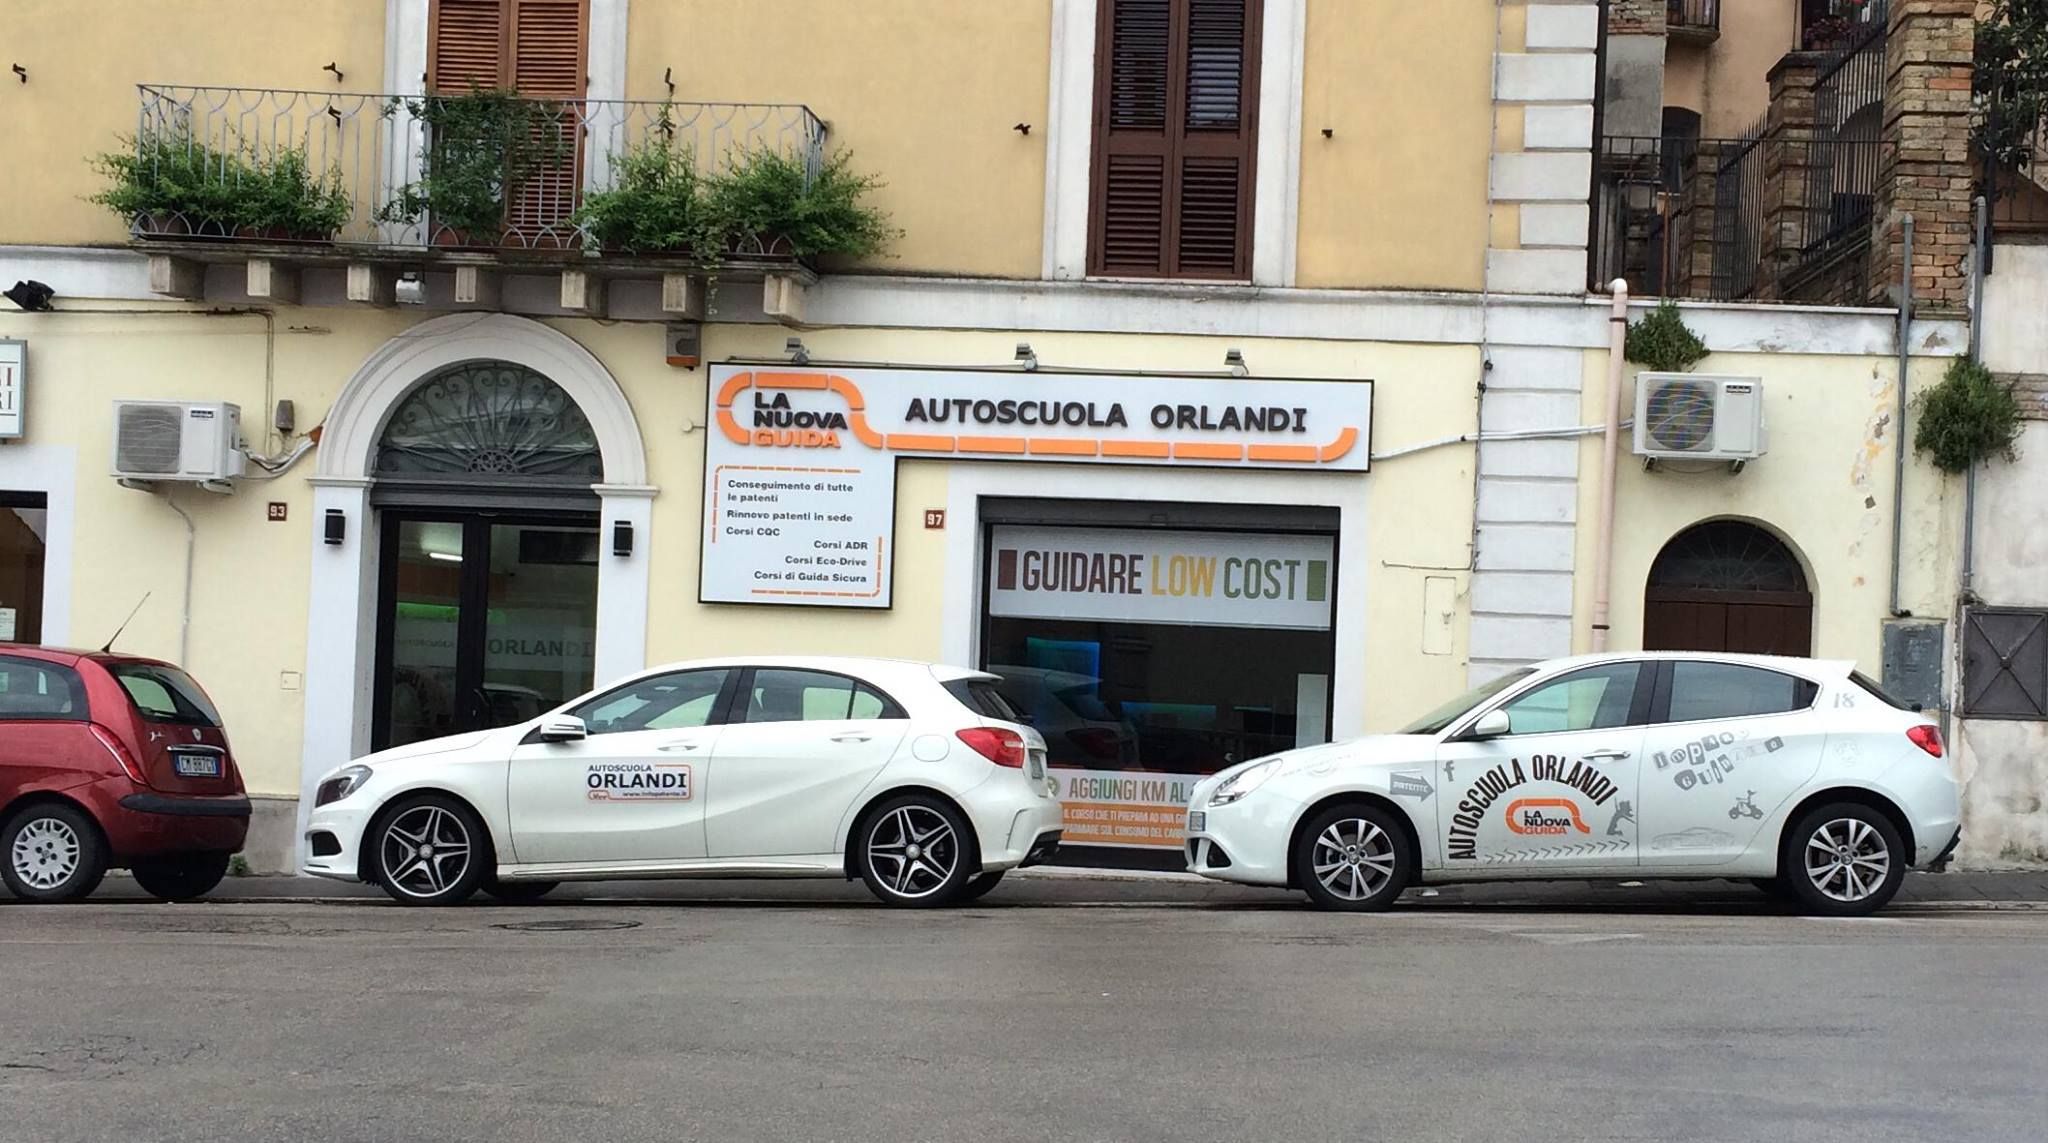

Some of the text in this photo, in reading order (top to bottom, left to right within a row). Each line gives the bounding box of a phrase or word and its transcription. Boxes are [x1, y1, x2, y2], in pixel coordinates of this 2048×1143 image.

[754, 392, 791, 409] LA
[753, 410, 848, 430] NUOVA
[905, 398, 1307, 433] AUTOSCUOLA ORLANDI
[753, 430, 841, 449] GUIDA
[728, 479, 853, 492] Conseguimento di tutte
[727, 493, 778, 505] le patenti
[270, 506, 286, 517] 93
[727, 510, 853, 523] Rinnovo patenti in sede
[927, 513, 943, 526] 97
[726, 527, 781, 537] Corsi CQC
[814, 540, 868, 550] Corsi ADR
[785, 556, 867, 567] Corsi Eco-Drive
[754, 571, 867, 583] Corsi di Guida Sicura
[1022, 550, 1302, 600] GUIDARE LOW COST
[488, 638, 593, 657] ORLANDI
[588, 764, 652, 772] AUTOSCUOLA
[587, 773, 687, 788] ORLANDI
[1069, 777, 1188, 803] AGGIUNGI KM AL
[1448, 754, 1619, 860] AUTOSCUOLA ORLANDI
[1524, 810, 1542, 818] LA
[1524, 818, 1571, 827] NUOVA
[1523, 827, 1567, 835] GUIDA
